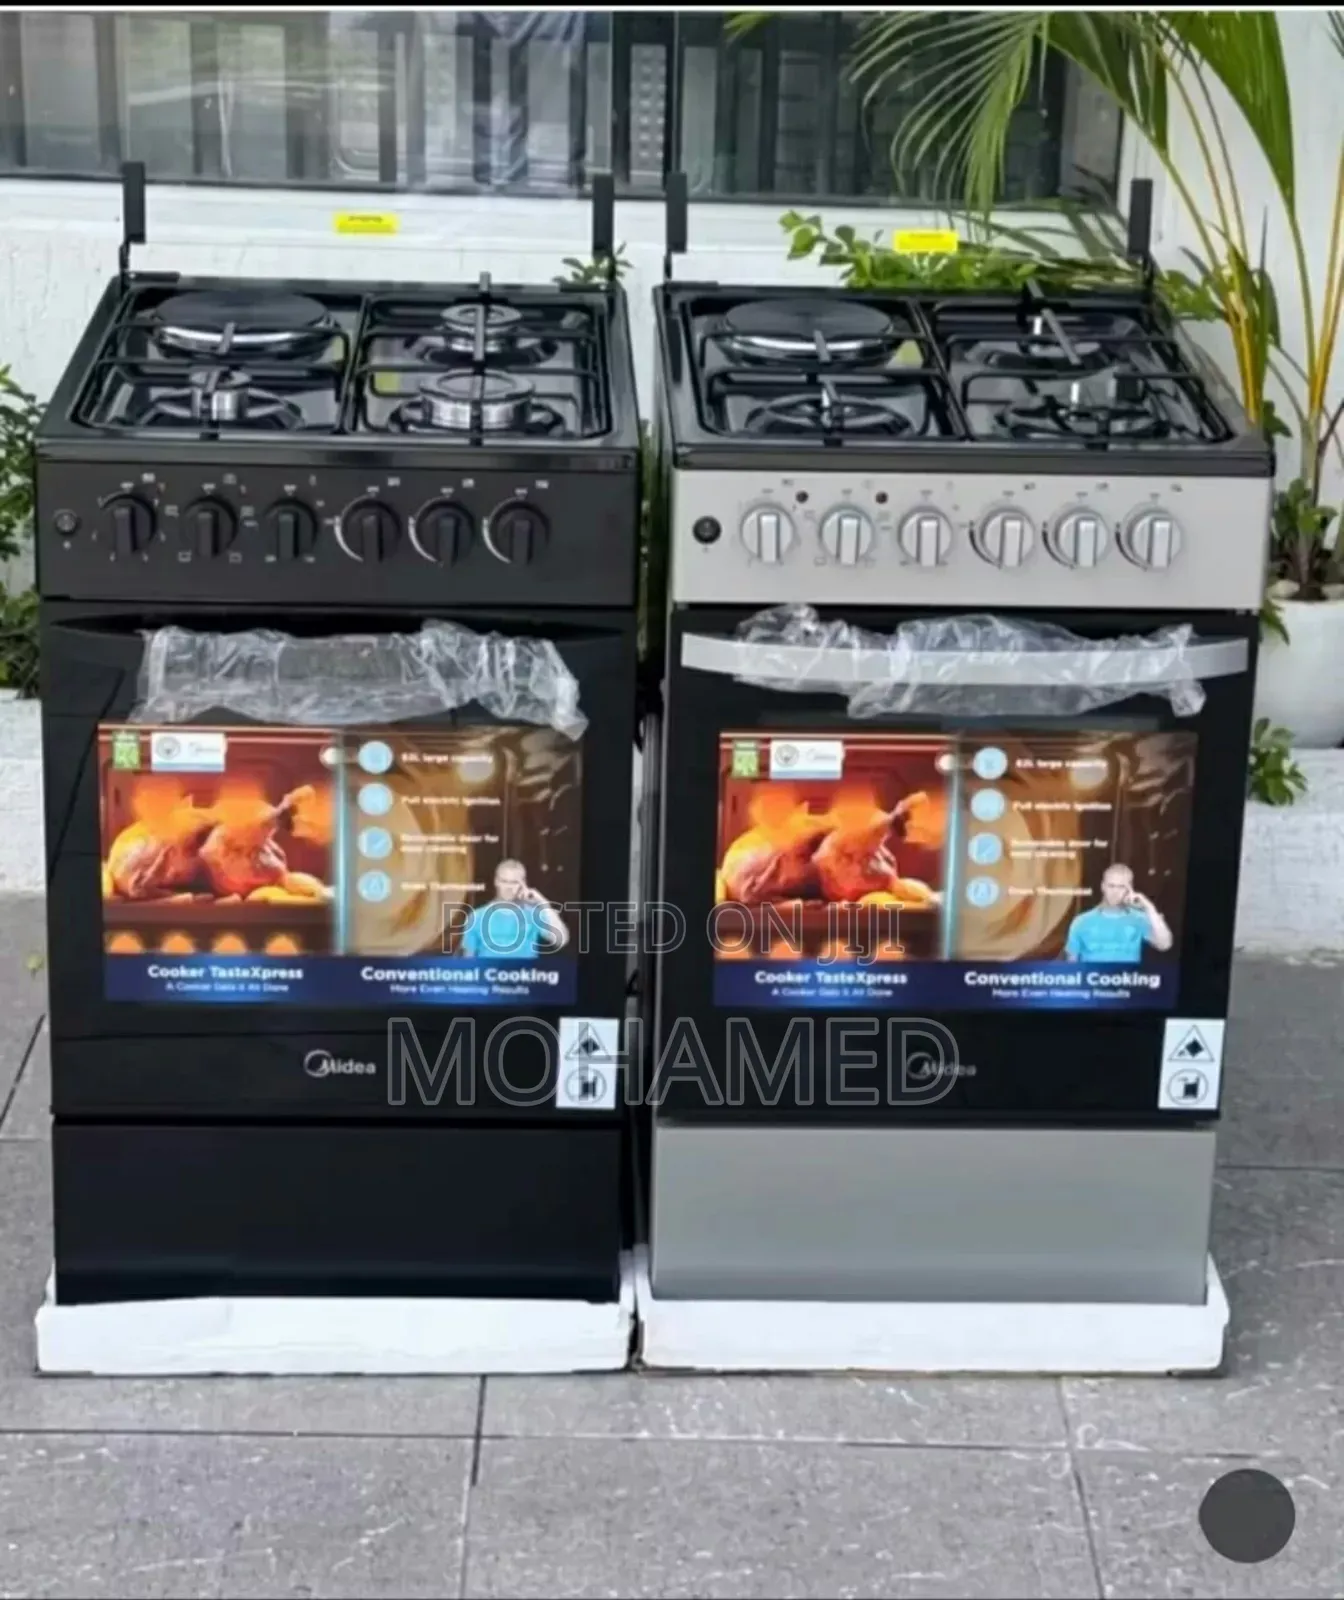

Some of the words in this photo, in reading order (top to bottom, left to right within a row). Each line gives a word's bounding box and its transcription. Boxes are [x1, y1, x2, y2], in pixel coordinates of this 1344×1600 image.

[147, 964, 205, 979] Cooker
[209, 965, 304, 981] TasteXpress
[361, 966, 479, 981] Conventional
[484, 967, 559, 986] Cooking
[755, 970, 811, 984] Cooker
[815, 971, 908, 986] TasteXpress
[964, 971, 1081, 986] Conventional
[1086, 972, 1161, 989] Cooking
[303, 1049, 376, 1078] Midea
